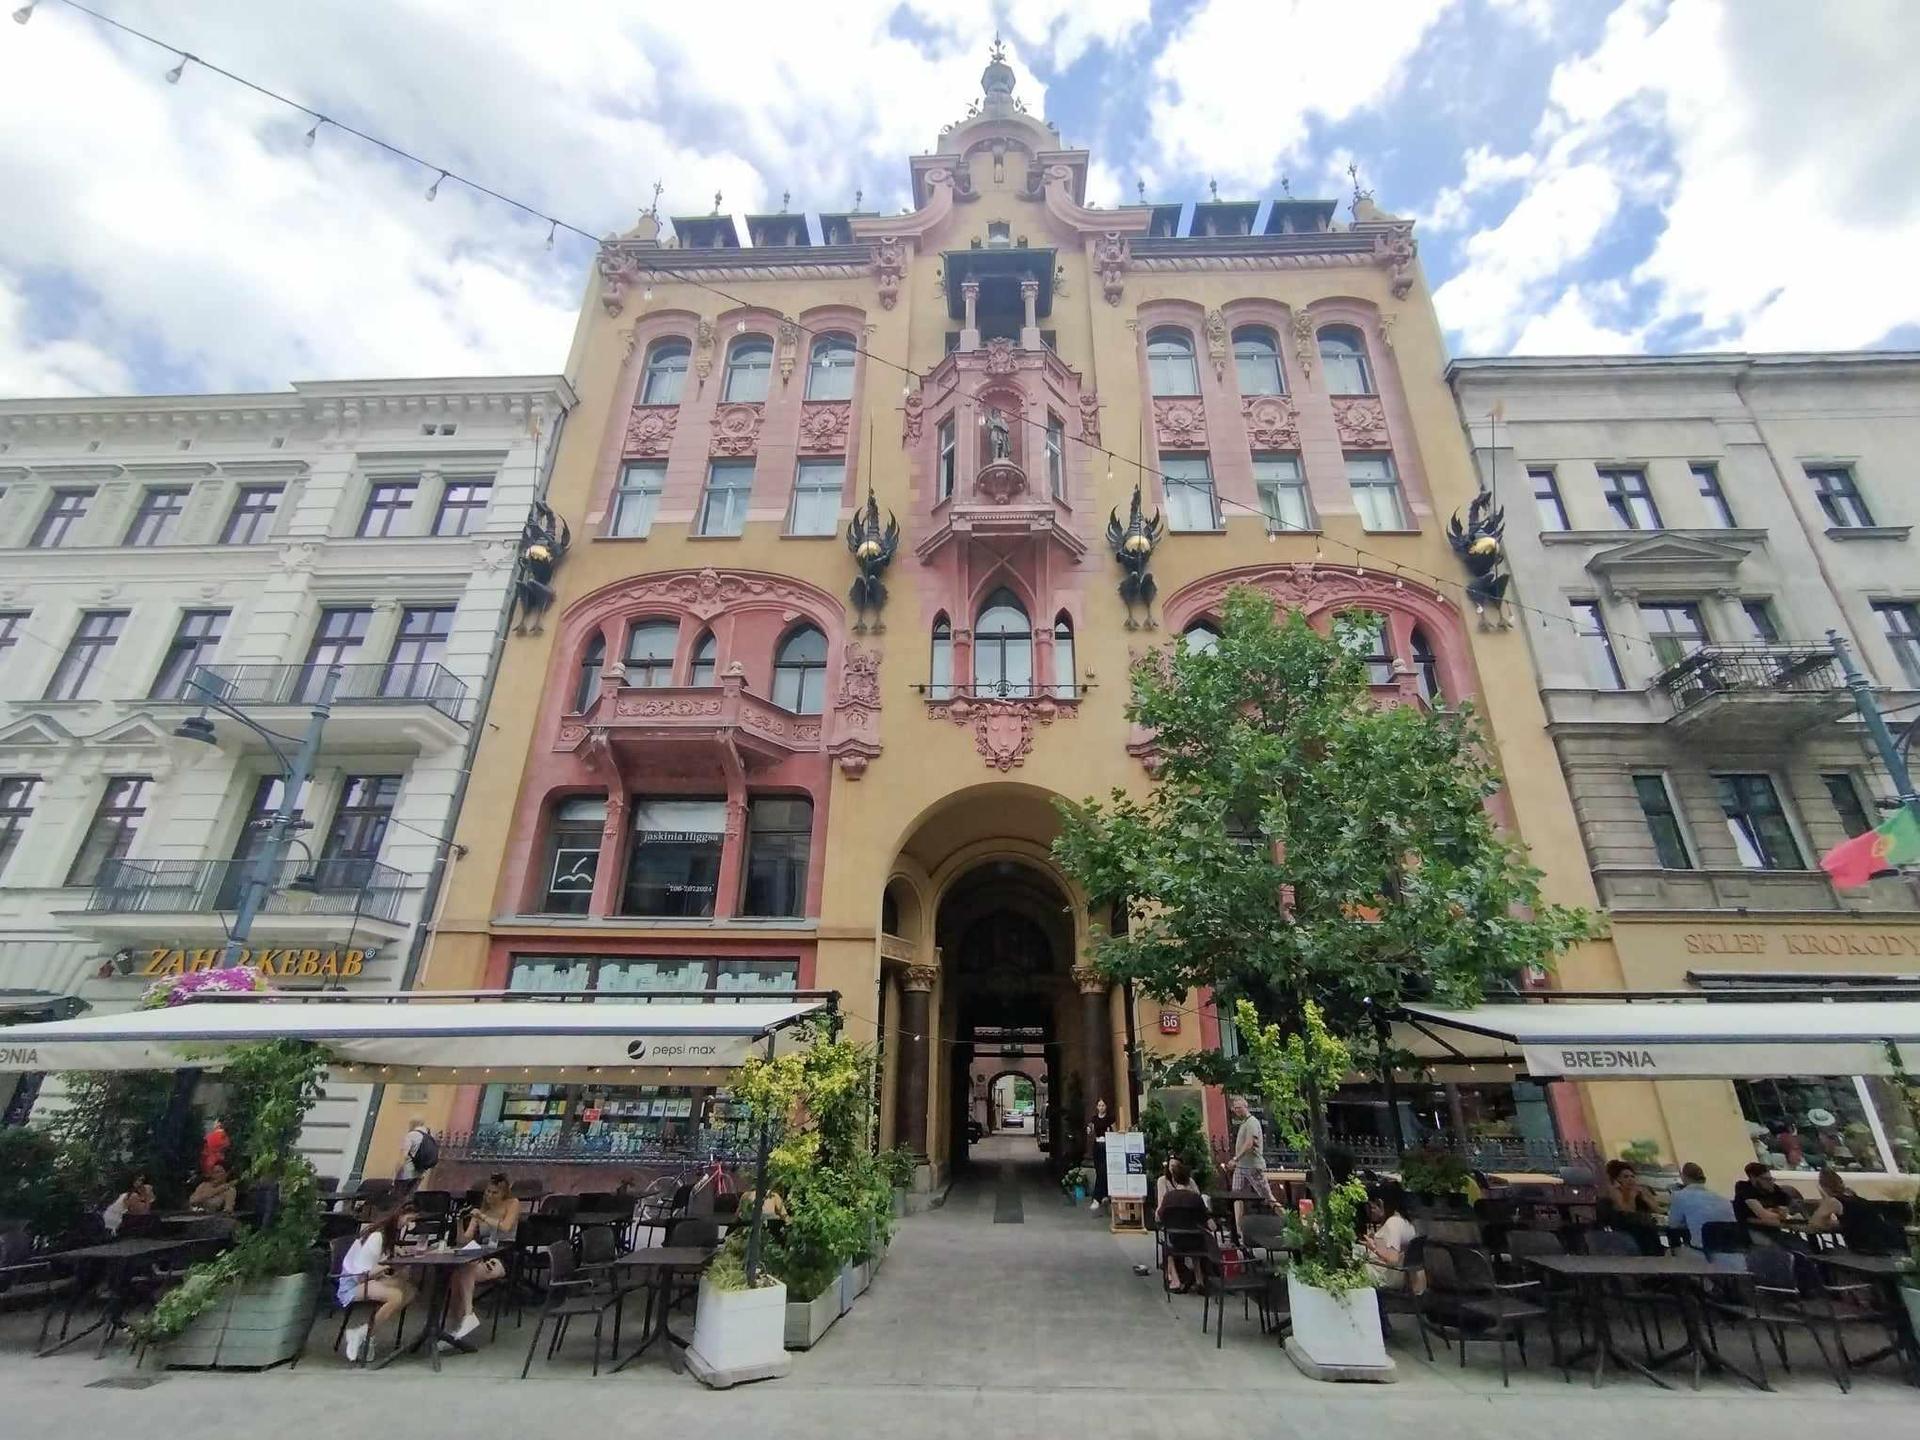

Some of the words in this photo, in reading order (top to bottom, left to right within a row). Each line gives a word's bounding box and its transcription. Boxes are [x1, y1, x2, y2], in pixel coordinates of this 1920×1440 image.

[1684, 934, 1767, 954] SKLEP
[653, 1044, 686, 1057] pepsi
[689, 1046, 716, 1055] max
